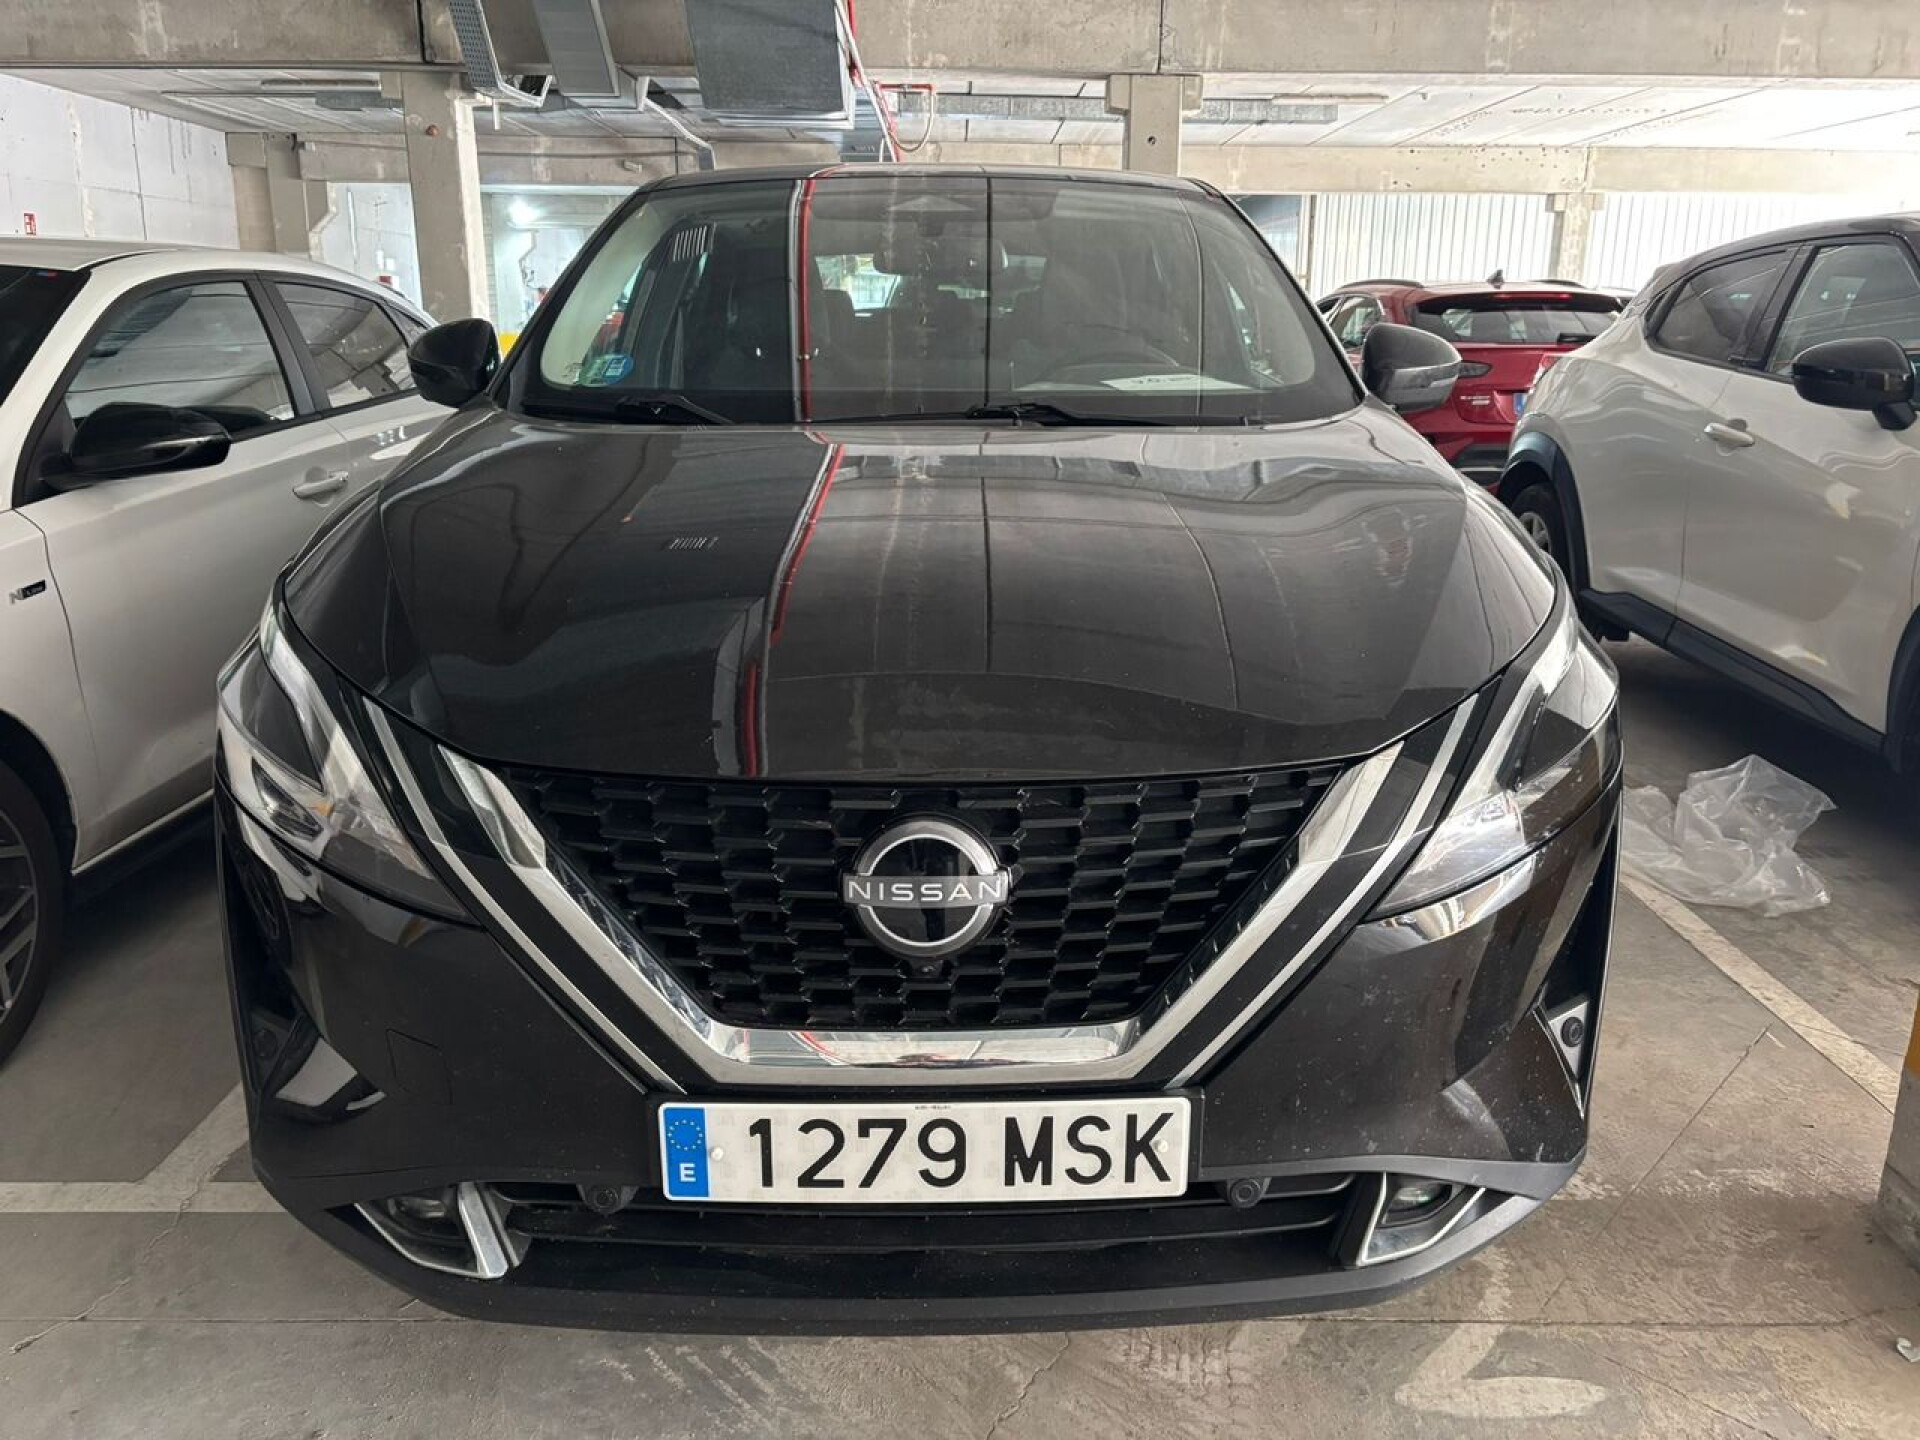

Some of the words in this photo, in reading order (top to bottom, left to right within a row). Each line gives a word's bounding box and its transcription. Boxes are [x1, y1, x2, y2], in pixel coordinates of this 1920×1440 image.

[848, 881, 1001, 902] NISSAN
[749, 1117, 967, 1189] 1279
[1004, 1112, 1174, 1187] MSK
[679, 1163, 697, 1183] E
